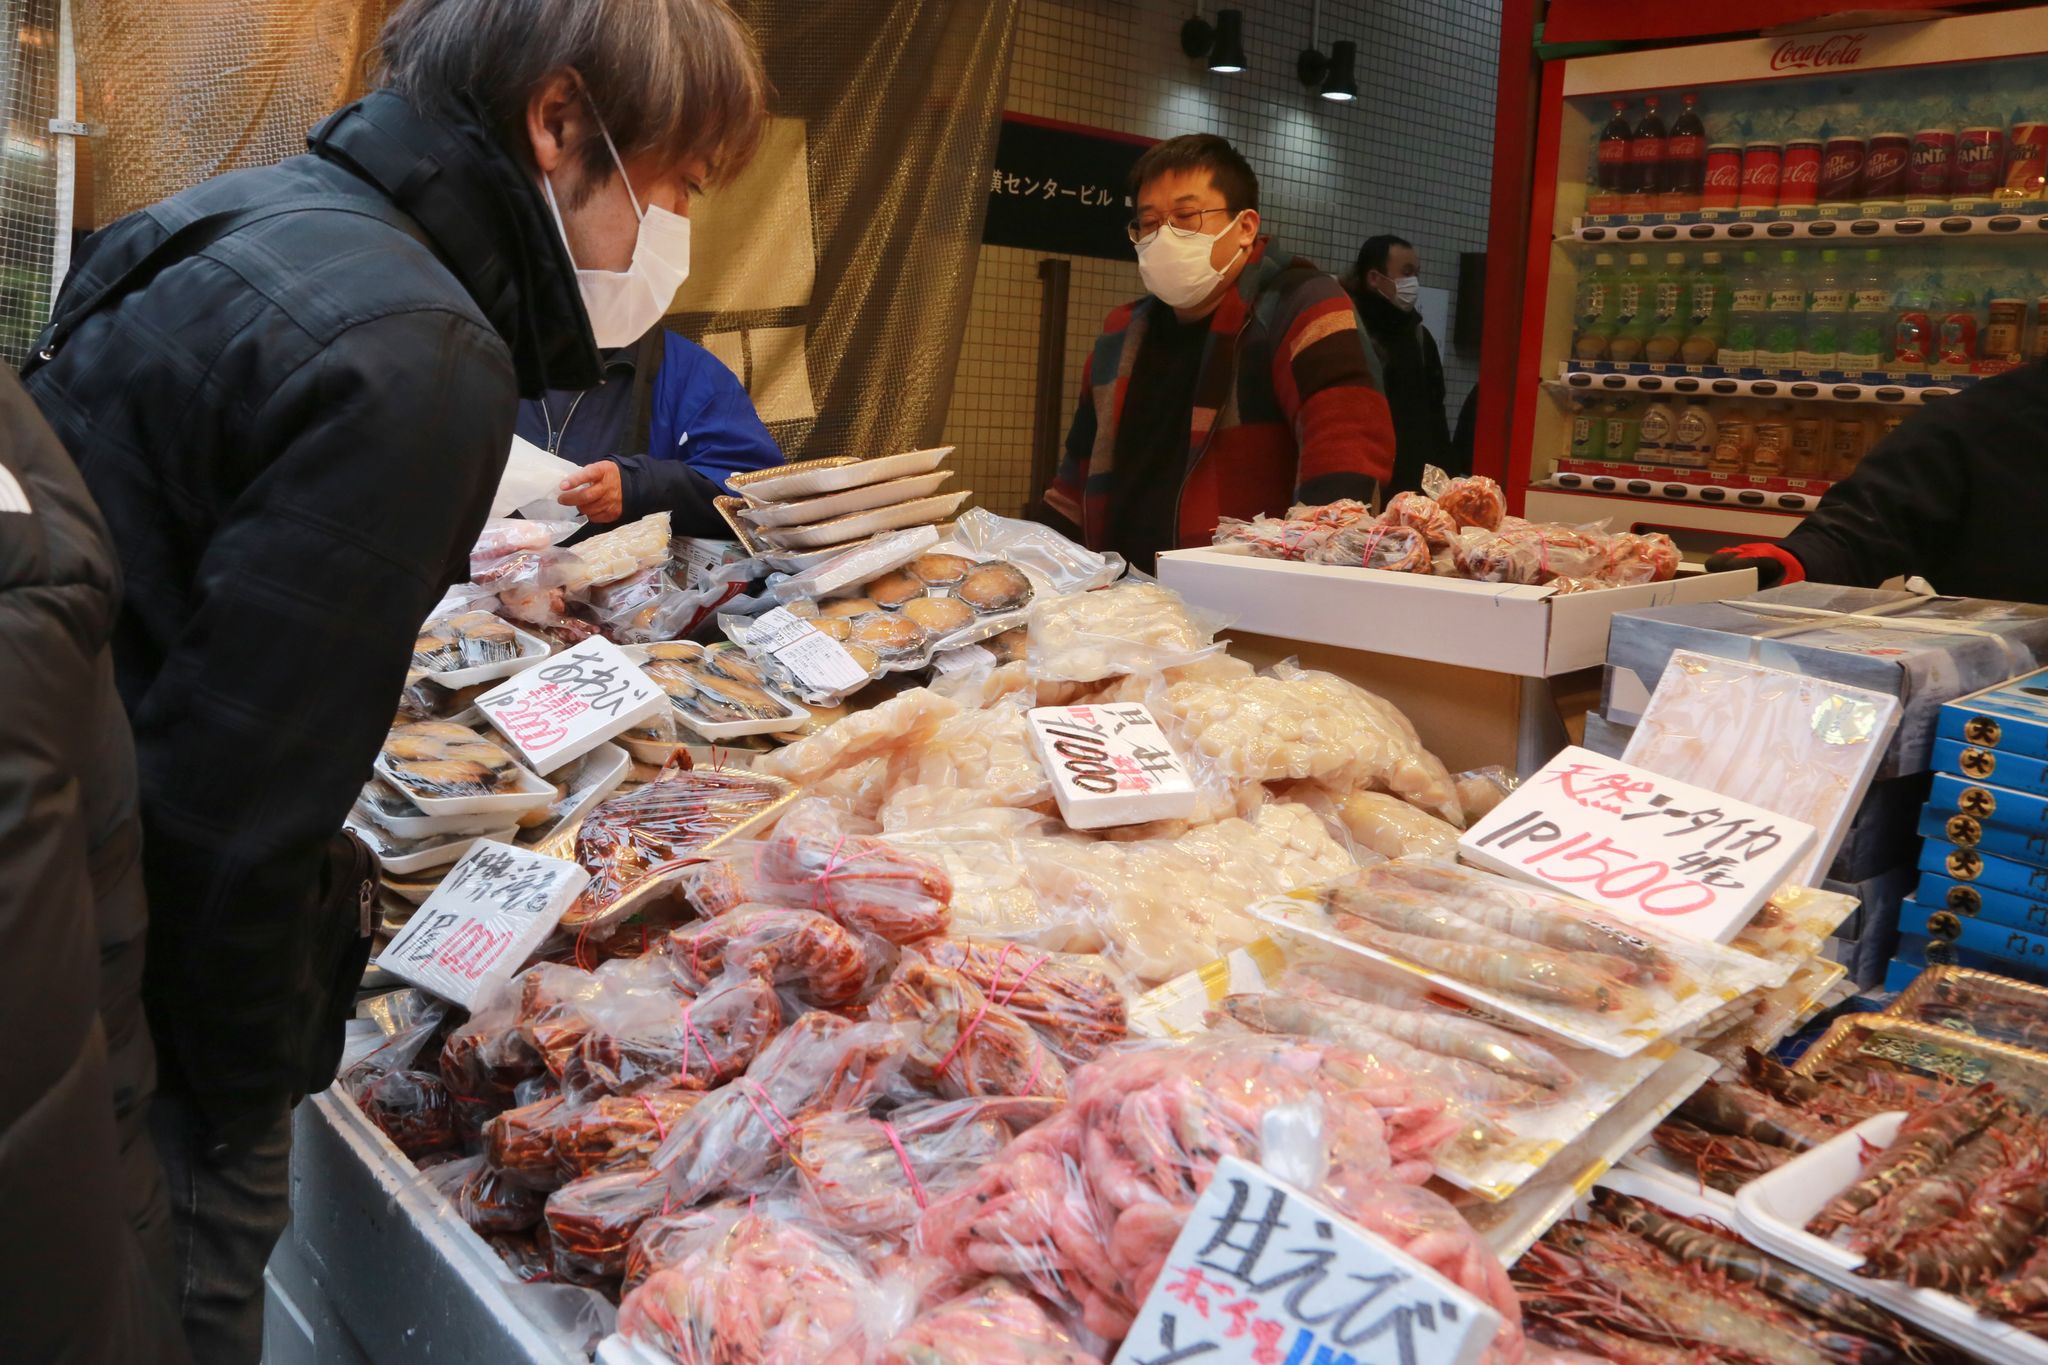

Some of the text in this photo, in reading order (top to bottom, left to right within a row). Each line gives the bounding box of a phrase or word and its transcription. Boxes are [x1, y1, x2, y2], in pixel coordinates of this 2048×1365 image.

[1770, 32, 1868, 72] Coca-Cola
[1912, 148, 1947, 165] FANTA
[1957, 145, 1994, 162] FANTA
[538, 652, 648, 716] あわび
[1540, 764, 1655, 815] 天然
[1523, 831, 1716, 916] 1500
[1195, 1178, 1460, 1365] 甘えび
